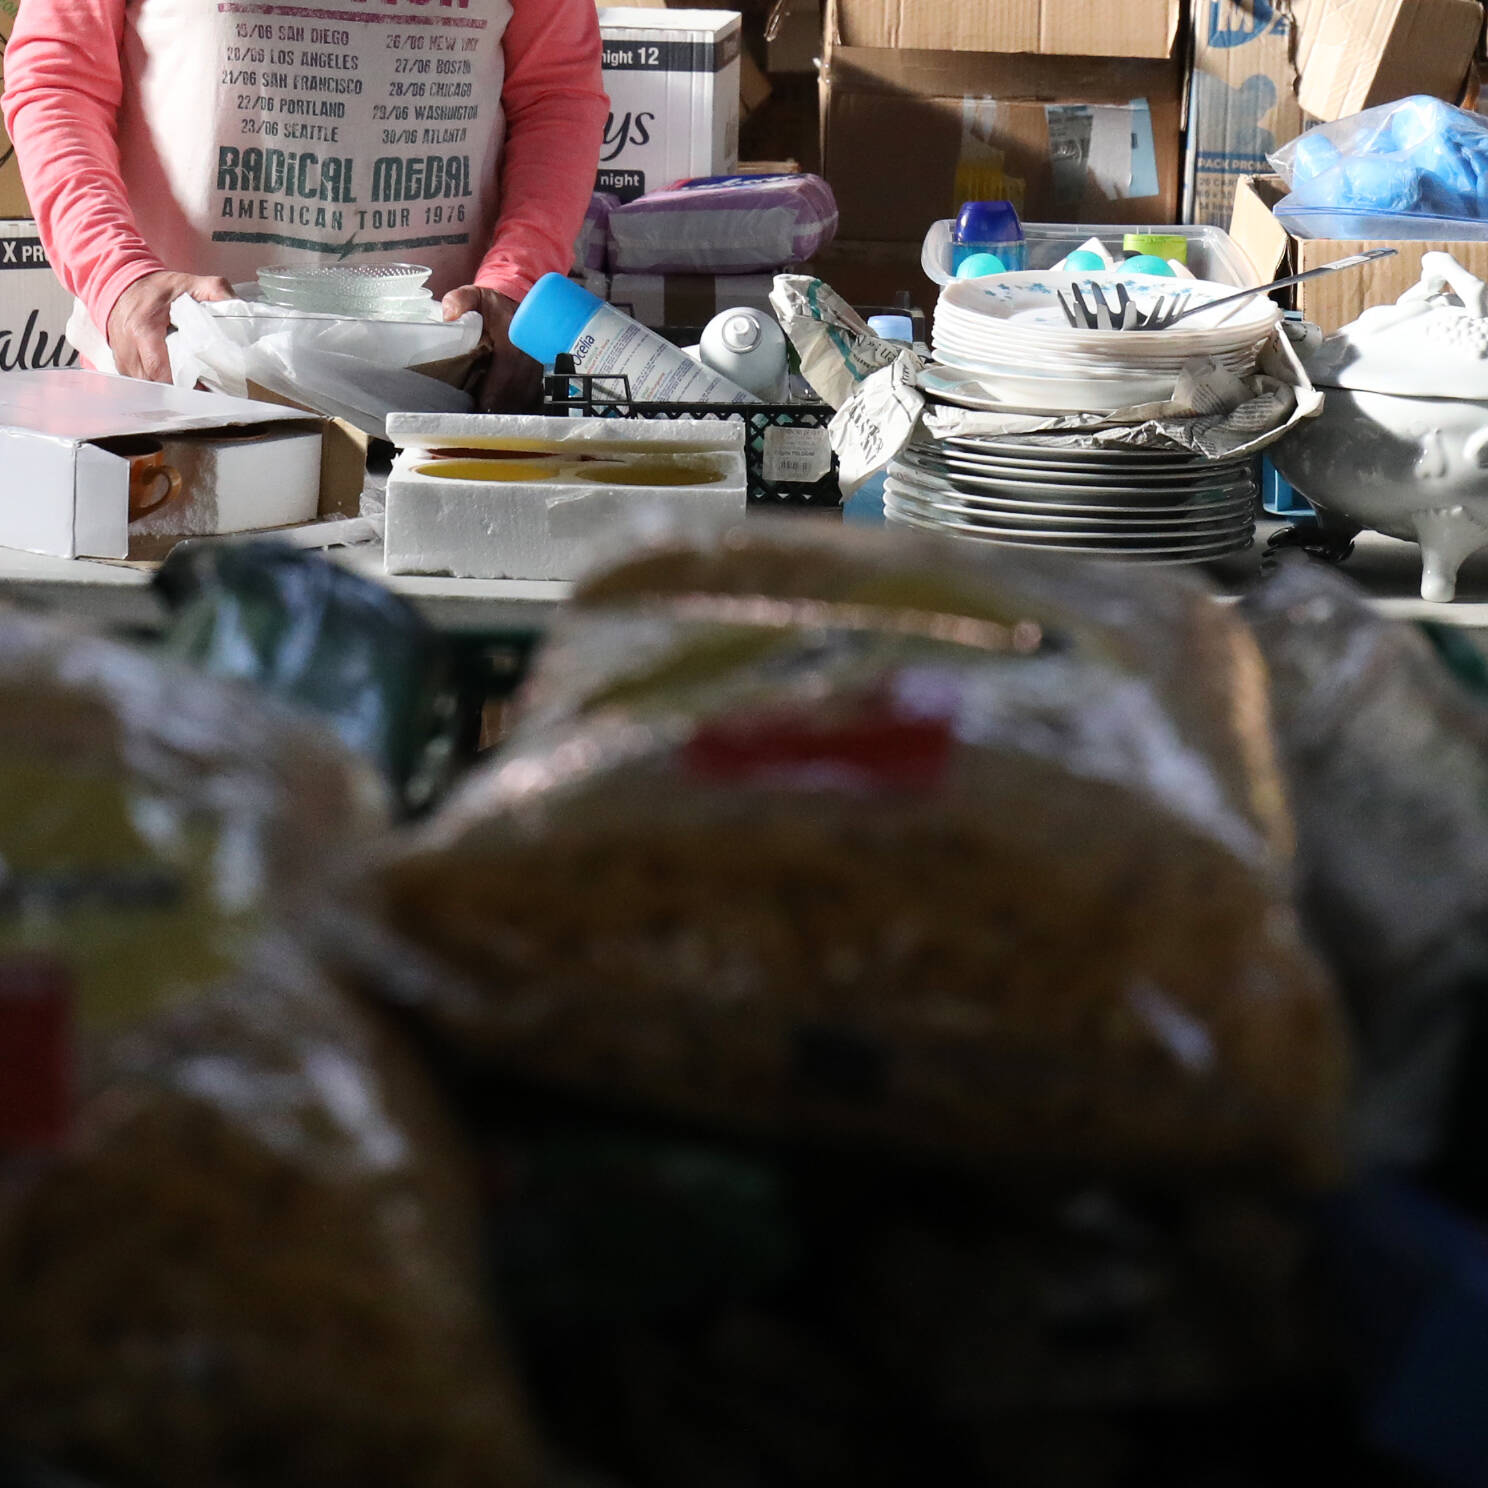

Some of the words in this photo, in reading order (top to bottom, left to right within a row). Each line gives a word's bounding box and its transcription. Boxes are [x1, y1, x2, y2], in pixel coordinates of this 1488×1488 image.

[279, 26, 304, 42] SAN
[312, 28, 350, 46] DIEGO
[429, 35, 456, 51] NEW
[270, 49, 294, 65] LOS
[301, 52, 359, 70] ANGELES
[395, 58, 431, 73] 27/06
[638, 47, 659, 65] 12
[222, 70, 256, 85] 21/06
[262, 72, 287, 88] SAN
[293, 75, 363, 95] FRANCISCO
[389, 82, 426, 97] 28/06
[429, 82, 472, 97] CHICAGO
[237, 95, 274, 112] 22/06
[280, 98, 345, 118] PORTLAND
[372, 104, 409, 120] 29/06
[414, 104, 478, 121] WASHINGTON
[241, 119, 279, 137] 23/06
[284, 123, 339, 143] SEATTLE
[382, 128, 418, 145] 30/06
[422, 128, 467, 144] ATLANTA
[1197, 158, 1229, 170] PACK
[371, 155, 473, 203] MEDAL
[601, 173, 639, 188] night
[221, 197, 343, 231] AMERICAN
[358, 208, 411, 230] TOUR
[425, 204, 466, 226] 1976
[3, 241, 17, 263] X
